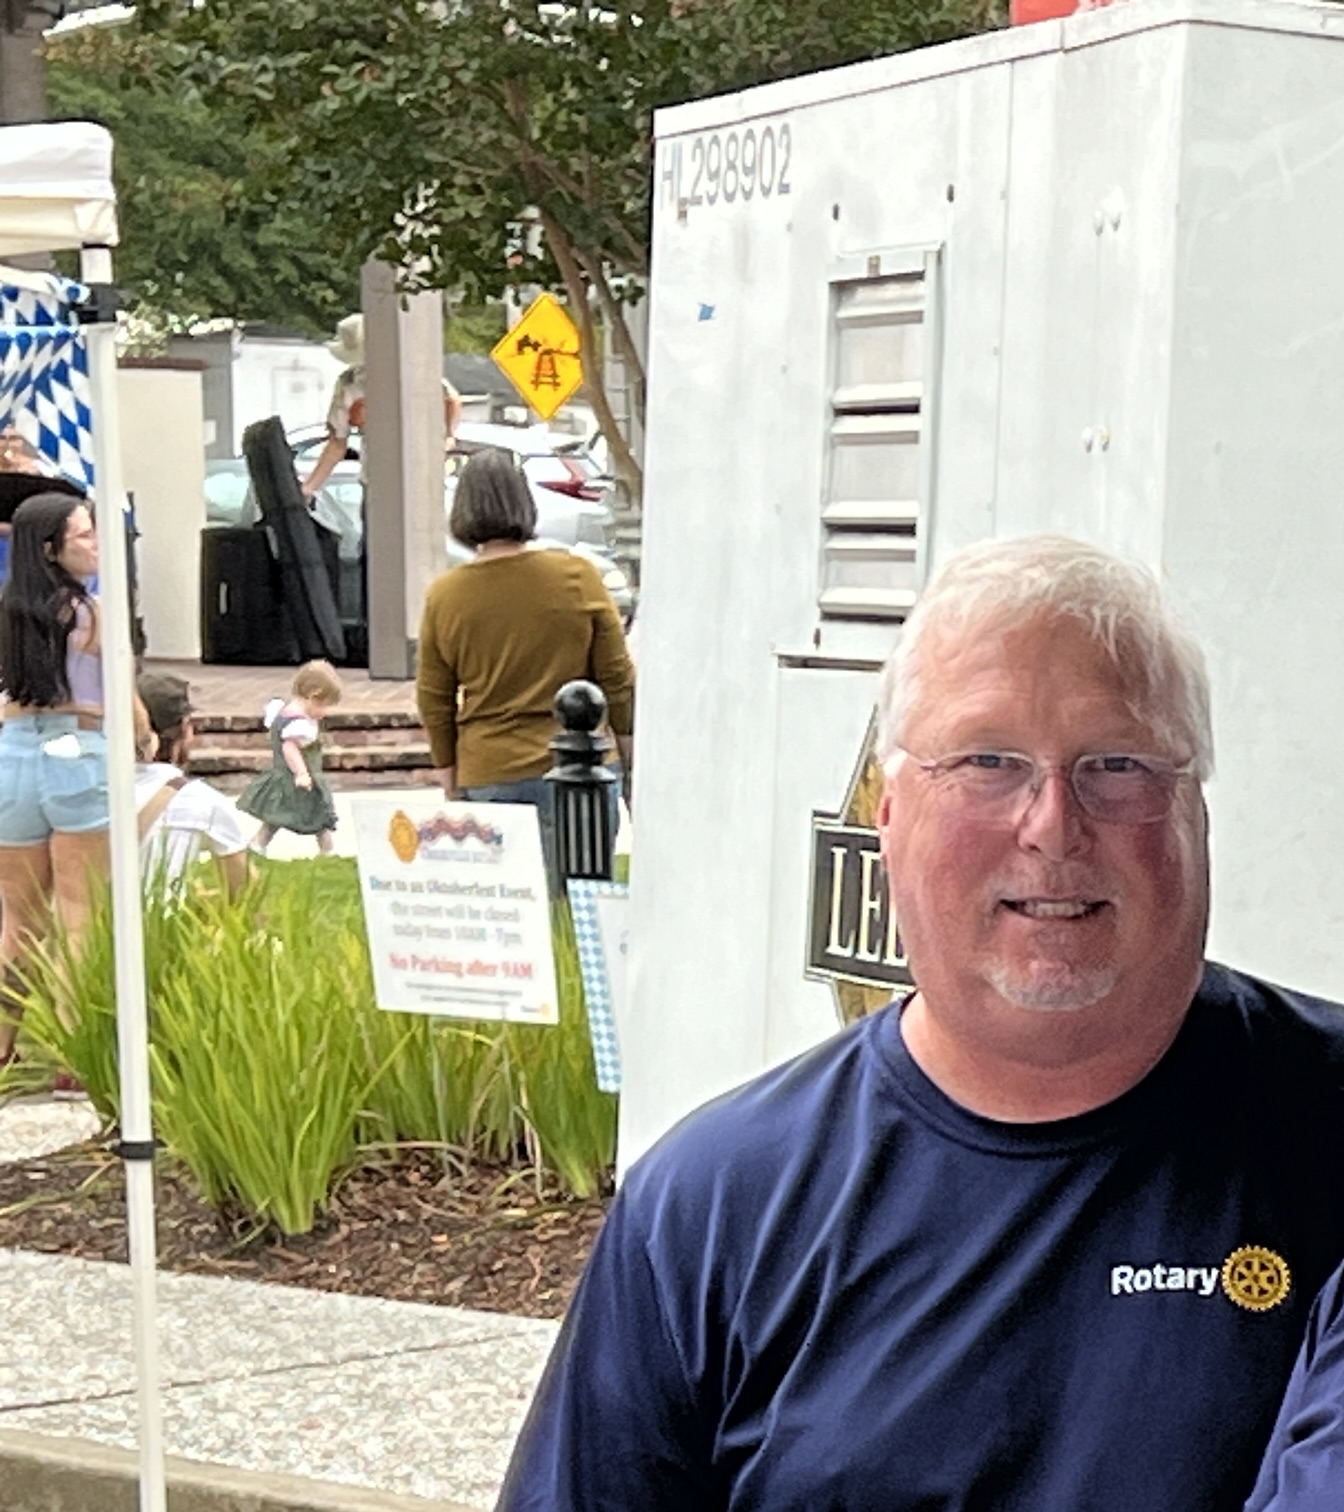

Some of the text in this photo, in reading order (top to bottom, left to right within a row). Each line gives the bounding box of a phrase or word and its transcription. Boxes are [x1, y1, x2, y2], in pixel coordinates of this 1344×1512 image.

[389, 953, 534, 979] No Parking after 9AM
[1111, 1263, 1219, 1296] Rotary
